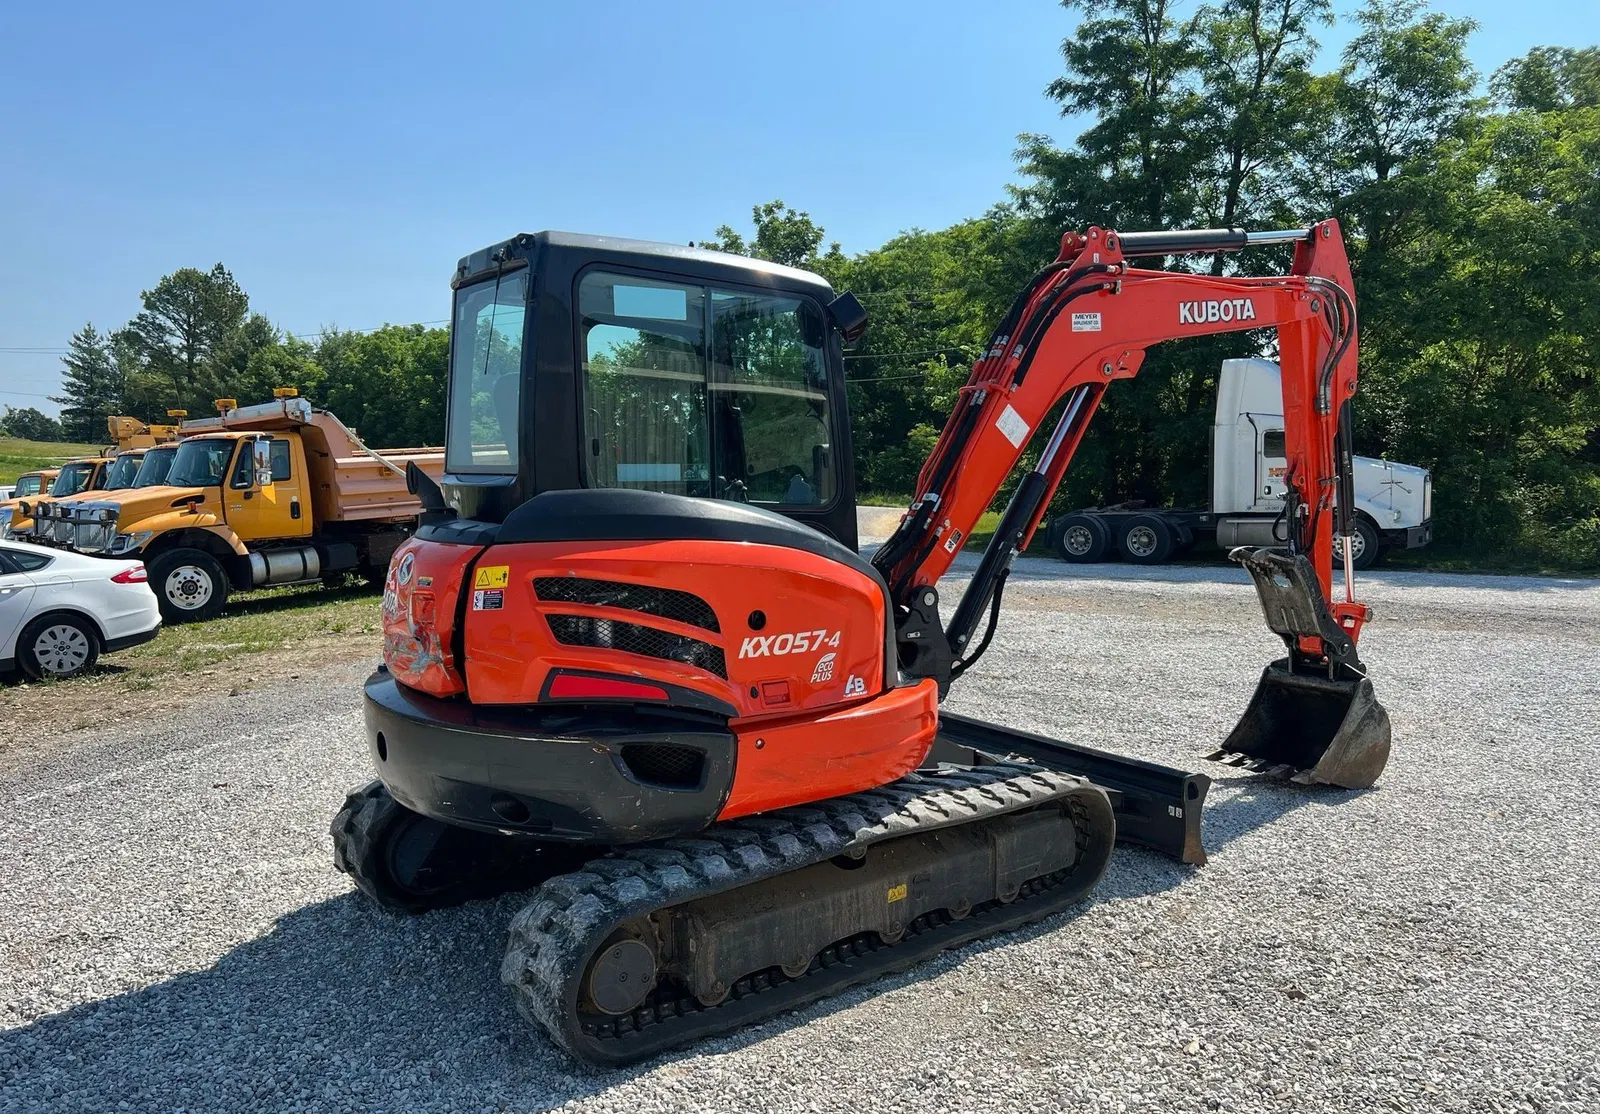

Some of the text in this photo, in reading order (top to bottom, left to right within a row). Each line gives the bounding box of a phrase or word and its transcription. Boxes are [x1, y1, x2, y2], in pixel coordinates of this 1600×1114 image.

[1179, 299, 1255, 324] KUBOTA
[738, 629, 841, 659] KX057-4
[818, 661, 834, 673] eco
[810, 672, 832, 684] PLUS
